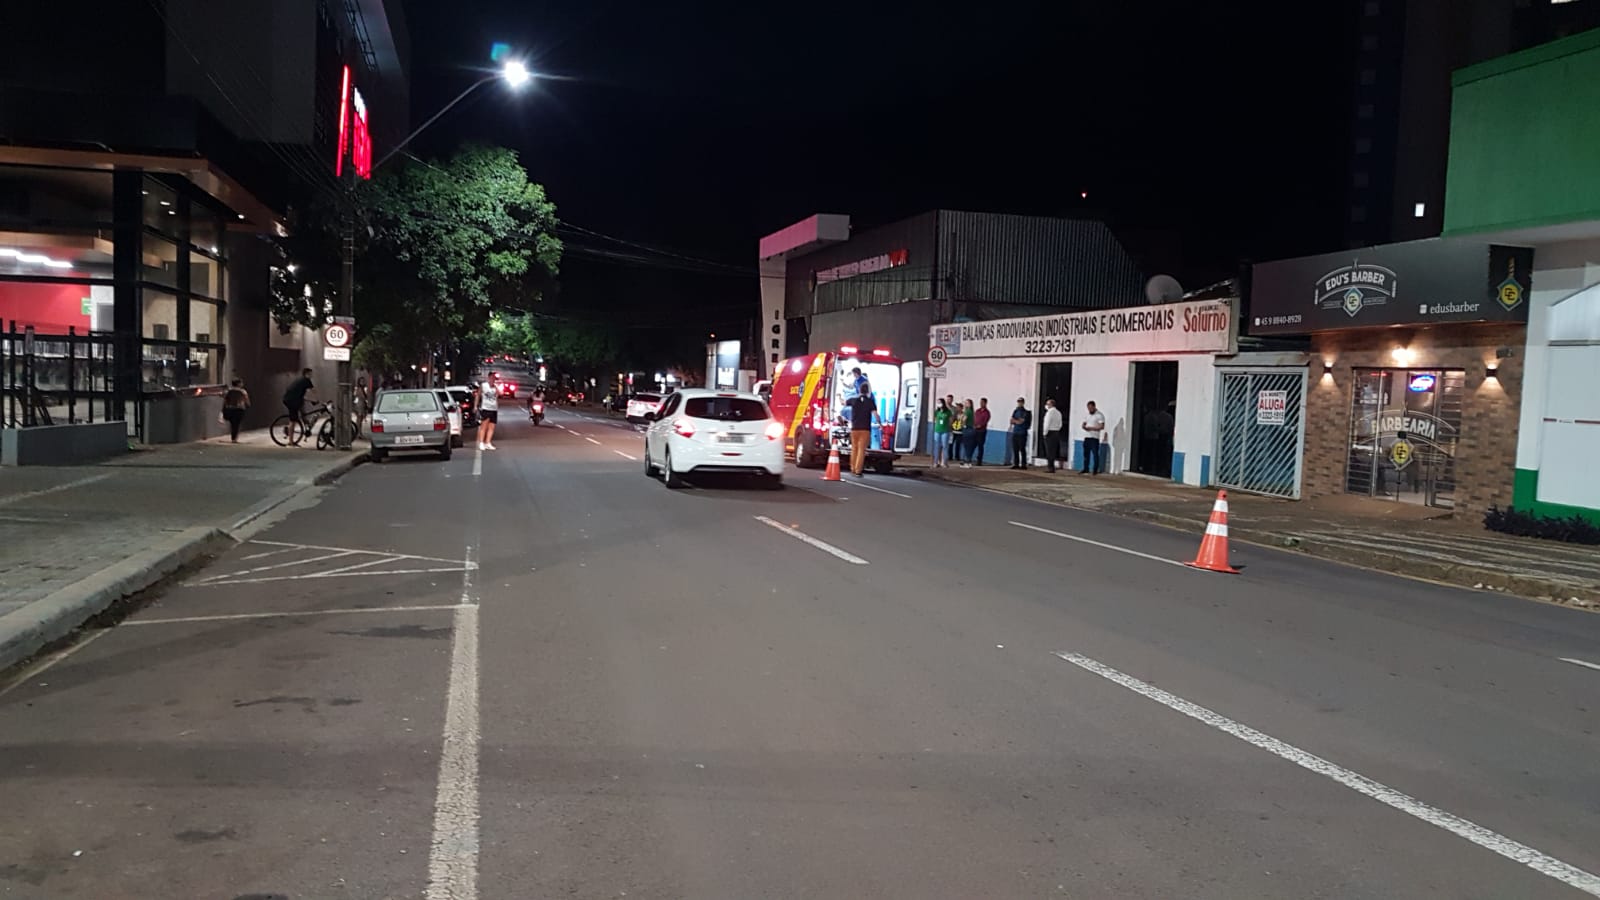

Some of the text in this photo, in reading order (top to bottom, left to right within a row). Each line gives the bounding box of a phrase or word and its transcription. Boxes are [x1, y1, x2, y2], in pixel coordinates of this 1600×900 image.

[1325, 271, 1385, 291] EDU'S BARBER
[1430, 301, 1480, 314] edusbarber
[1045, 316, 1097, 337] INDÚSTRIAIS
[1101, 315, 1107, 333] E
[1109, 309, 1174, 333] COMERCIAIS
[1183, 307, 1227, 333] Saturno
[330, 330, 344, 339] 60
[1025, 339, 1076, 353] 3223-7131
[931, 351, 943, 360] 60
[1259, 399, 1284, 410] ALUGA
[1371, 417, 1435, 439] BARBEARIA
